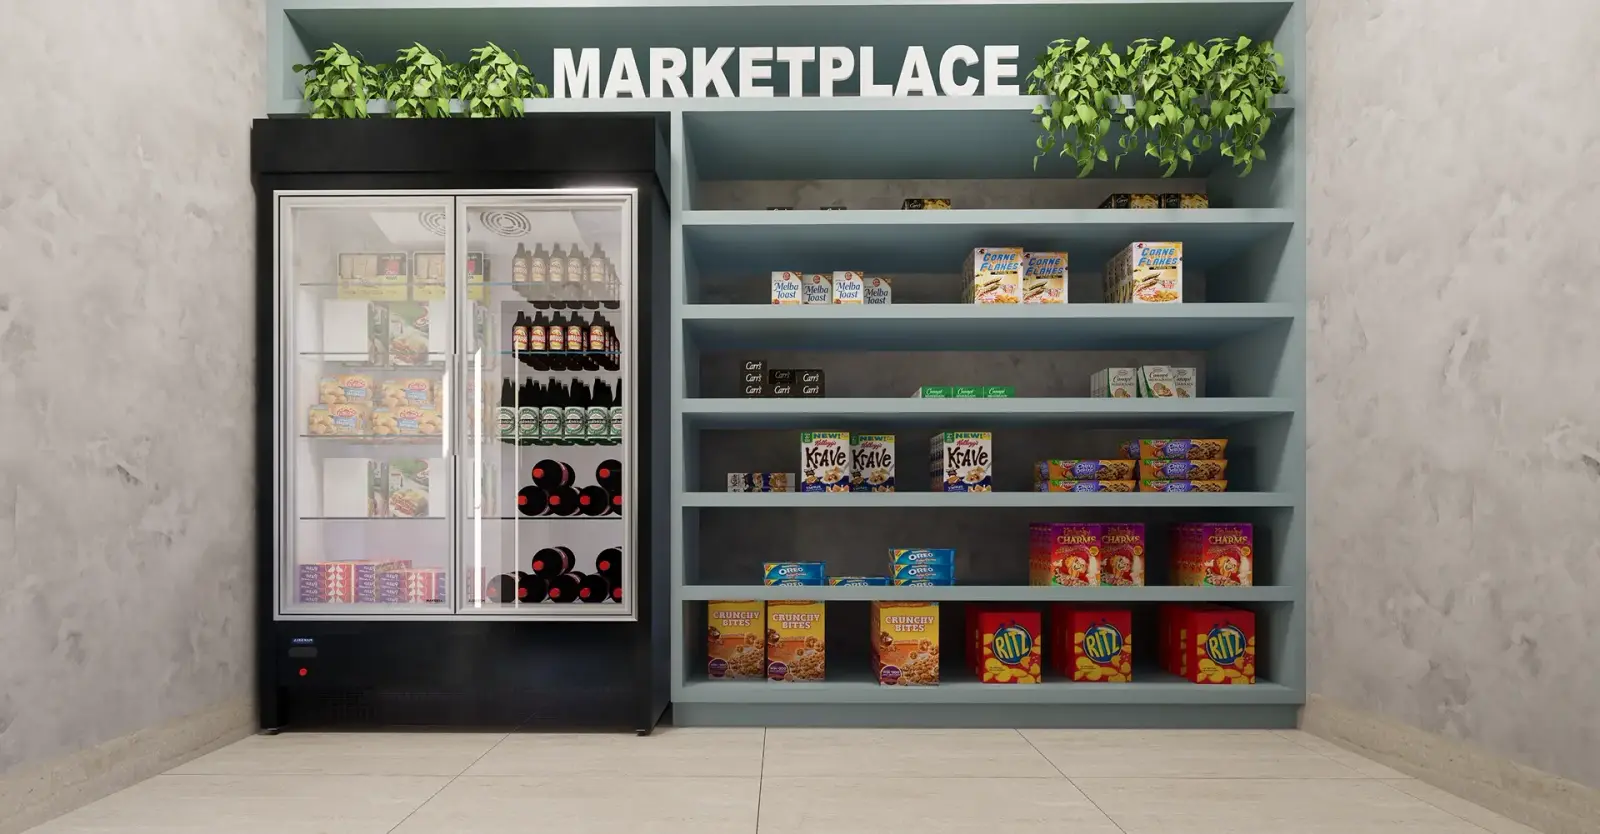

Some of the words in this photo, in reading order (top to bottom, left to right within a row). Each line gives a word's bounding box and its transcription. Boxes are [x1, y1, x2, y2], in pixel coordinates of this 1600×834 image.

[553, 45, 1020, 98] MARKETPLACE
[1138, 257, 1178, 266] FLAKES
[980, 262, 1019, 271] FLAKES
[1025, 267, 1064, 276] FLAKES
[774, 282, 799, 291] Melba
[804, 284, 829, 294] Melba
[836, 282, 860, 291] Melba
[777, 290, 796, 299] Toast
[839, 290, 858, 299] Toast
[864, 288, 889, 297] Melba
[807, 293, 826, 302] Toast
[1057, 535, 1097, 544] CHARMS
[1101, 535, 1140, 544] CHARMS
[1208, 535, 1248, 545] CHARMS
[908, 552, 933, 561] OREO
[778, 567, 803, 575] OREO
[908, 567, 933, 575] OREO
[713, 611, 760, 619] CRUNCHY
[772, 613, 820, 621] CRUNCHY
[885, 616, 934, 624] CRUNCHY
[782, 621, 811, 629] BITES
[895, 624, 925, 632] BITES
[994, 630, 1028, 659] RITZ
[1085, 630, 1119, 659] RITZ
[1209, 630, 1243, 659] RITZ
